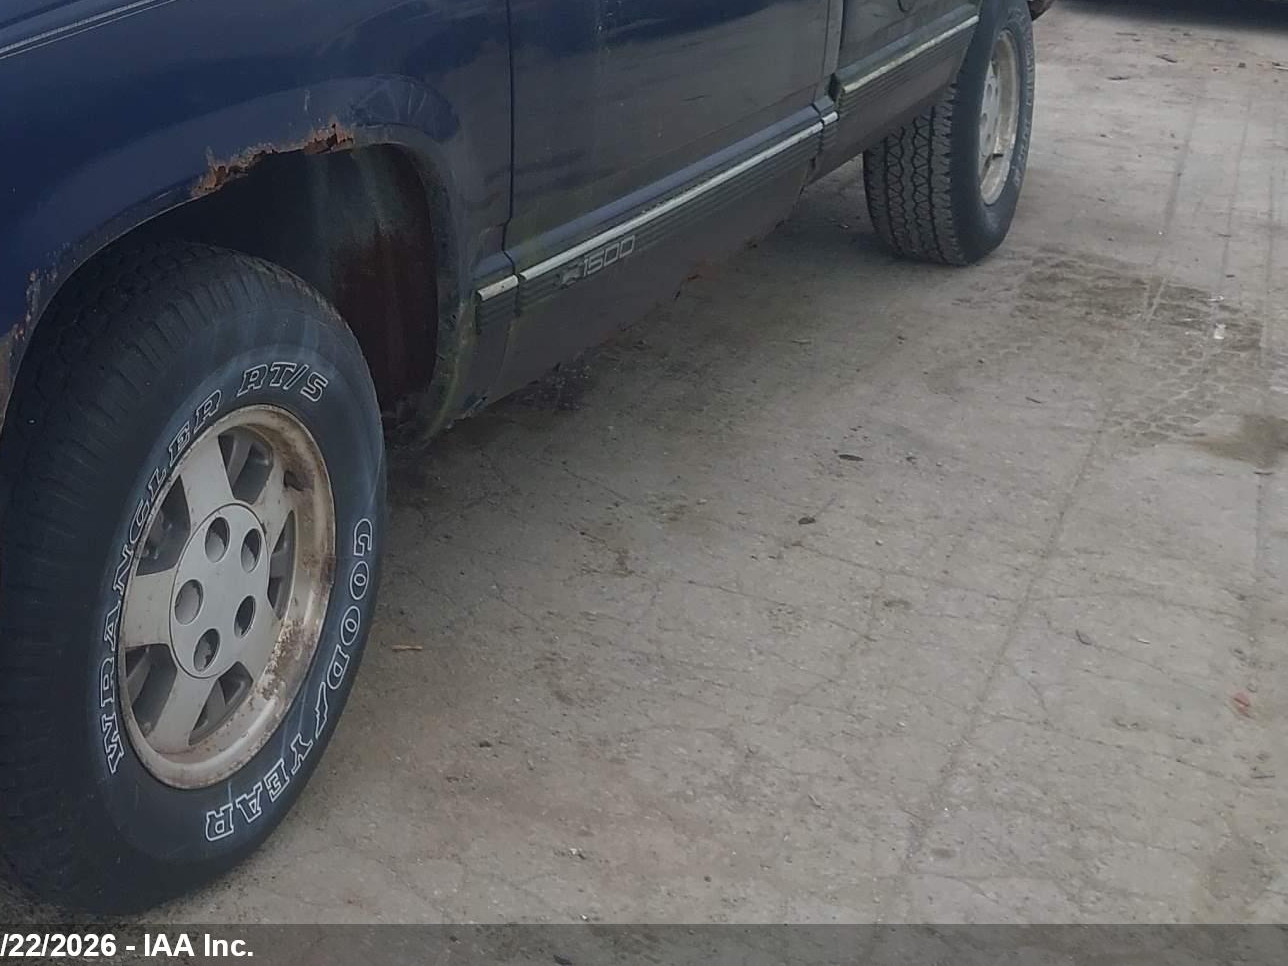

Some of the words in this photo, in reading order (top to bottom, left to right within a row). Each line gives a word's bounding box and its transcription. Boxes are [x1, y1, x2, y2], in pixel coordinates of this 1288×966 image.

[98, 389, 222, 773] WRANGLER
[236, 361, 329, 402] RT/S
[205, 518, 373, 842] GOODYEAR
